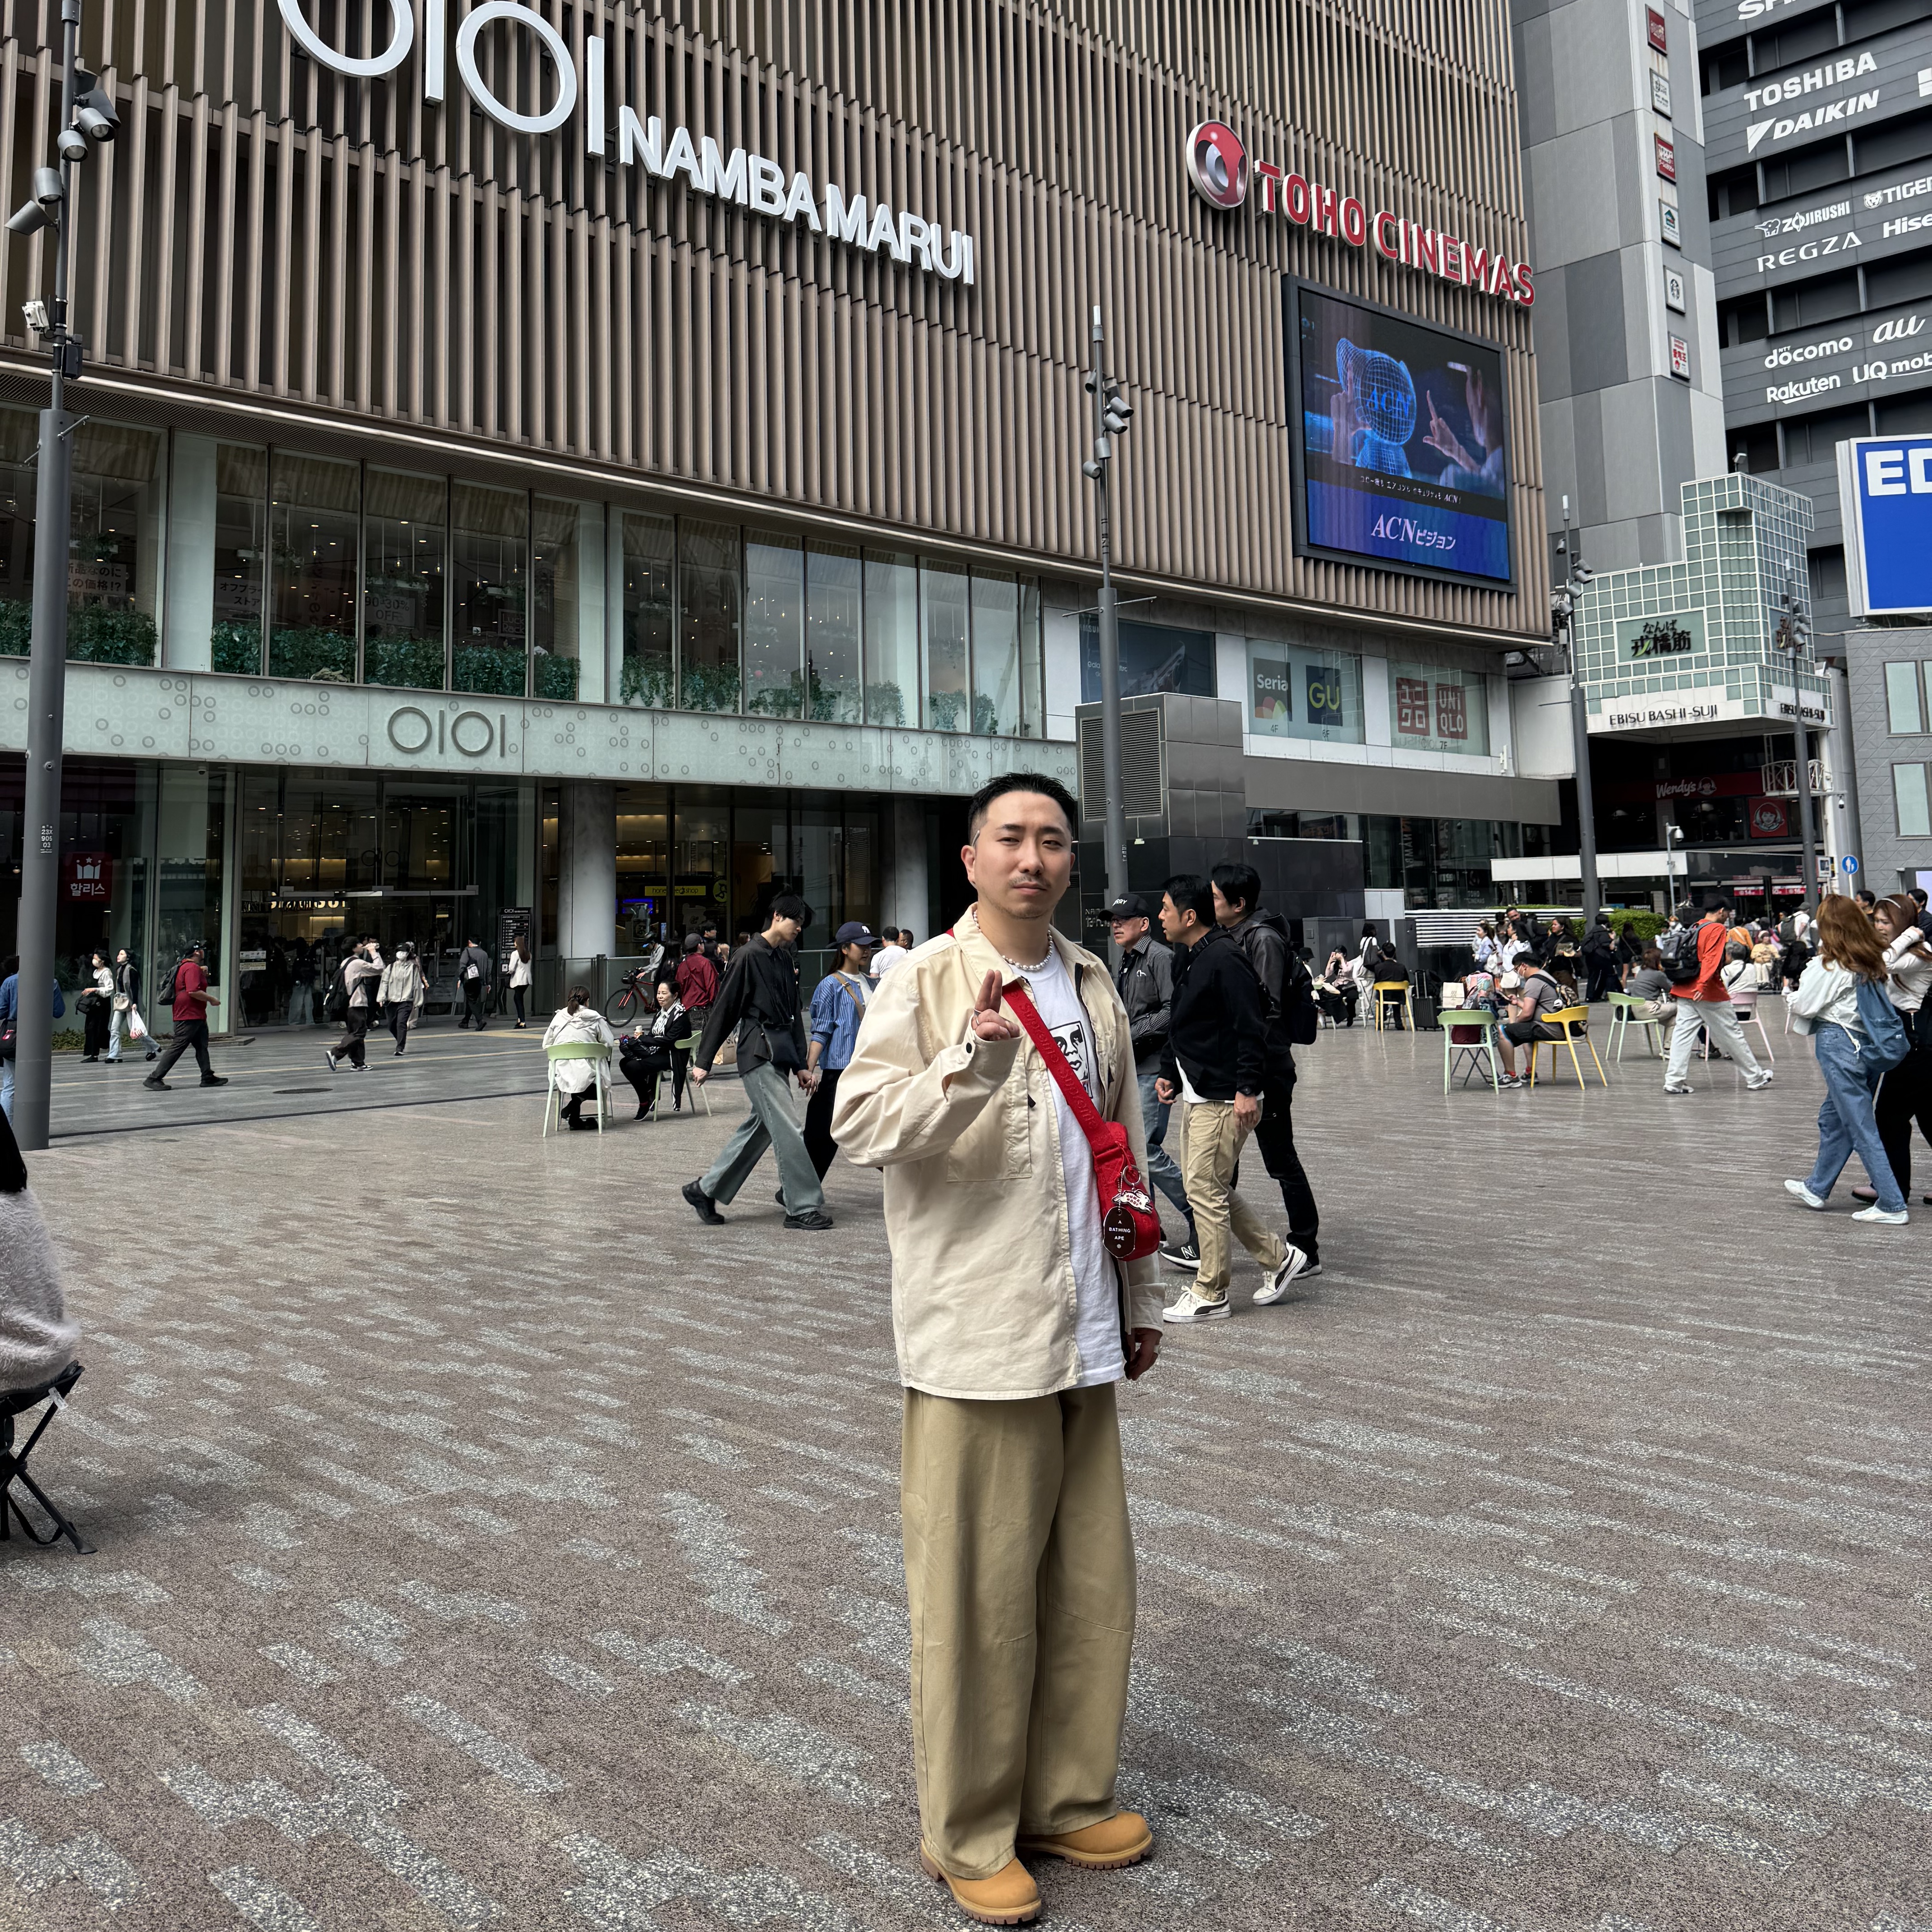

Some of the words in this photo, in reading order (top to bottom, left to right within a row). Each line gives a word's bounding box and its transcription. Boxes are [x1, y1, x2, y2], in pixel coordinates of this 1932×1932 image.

[1744, 52, 1877, 111] TOSHIBA
[1773, 90, 1879, 140] DAIKIN
[619, 105, 822, 233] NAMBA
[826, 183, 974, 285] MARUI
[1782, 201, 1850, 232] ZOJIRUSHI
[1254, 159, 1366, 247] TOHO
[1372, 210, 1535, 307] CINEMAS
[1757, 231, 1862, 272] REGZA
[1873, 315, 1926, 344] au
[1764, 337, 1853, 368] docomo
[1852, 361, 1887, 385] UQ
[1766, 375, 1841, 403] Rakuten
[1643, 619, 1677, 633] なんば
[1631, 630, 1691, 657] 戎橋筋
[1257, 674, 1288, 691] Seria
[1309, 682, 1340, 710] GU
[1439, 690, 1461, 711] UNI
[1270, 724, 1279, 733] 4F
[1440, 712, 1463, 734] QLO
[1609, 711, 1646, 726] EBISU
[1656, 779, 1696, 798] Wendy's
[70, 882, 106, 896] 할리스
